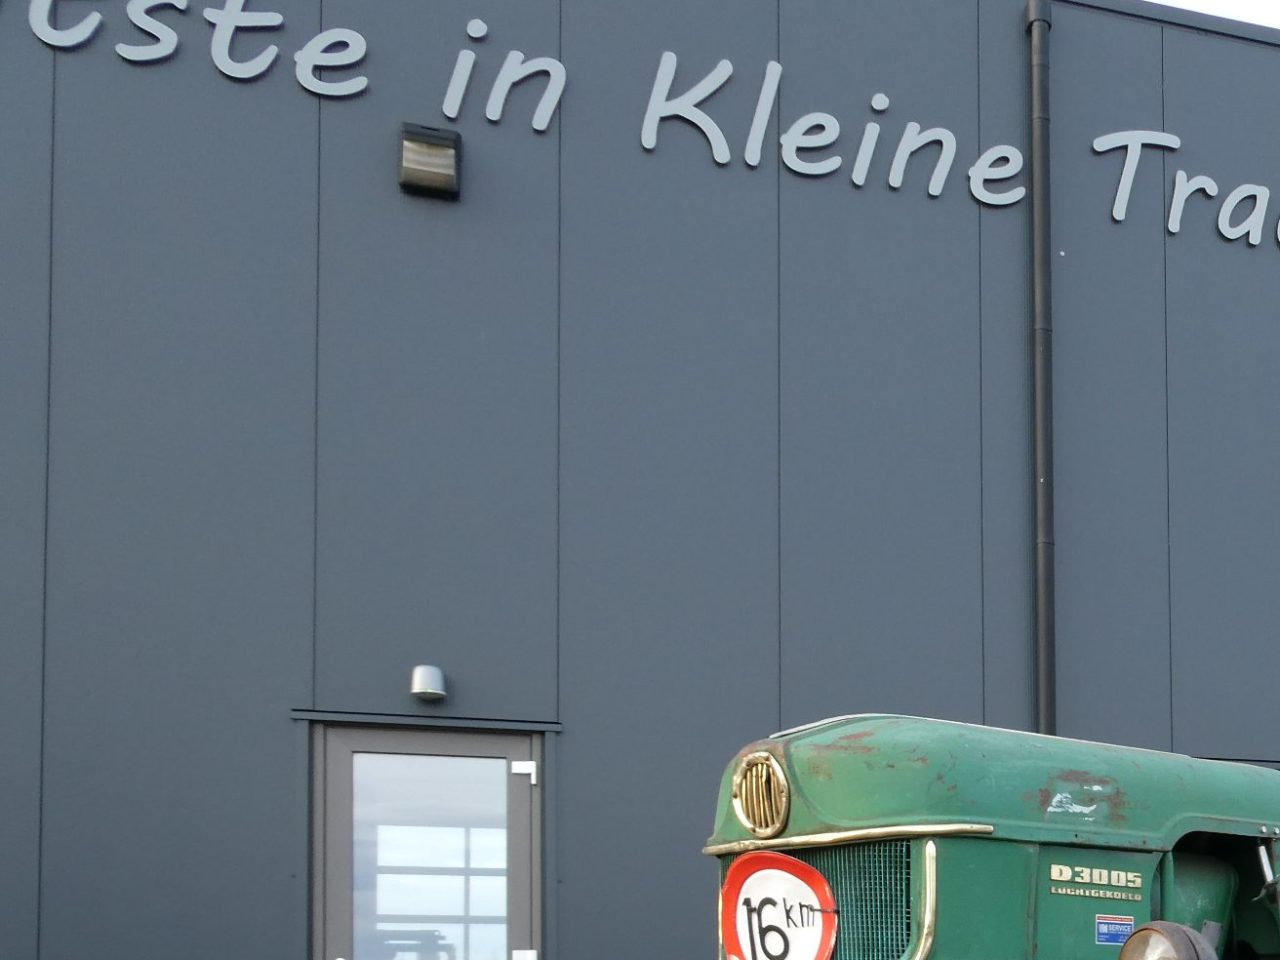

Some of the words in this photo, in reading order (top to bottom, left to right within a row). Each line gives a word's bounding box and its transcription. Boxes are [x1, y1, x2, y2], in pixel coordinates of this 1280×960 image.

[442, 18, 567, 131] in
[640, 50, 1027, 205] Kleine
[1050, 885, 1142, 901] LUCHTGEKOELD
[783, 898, 815, 928] km
